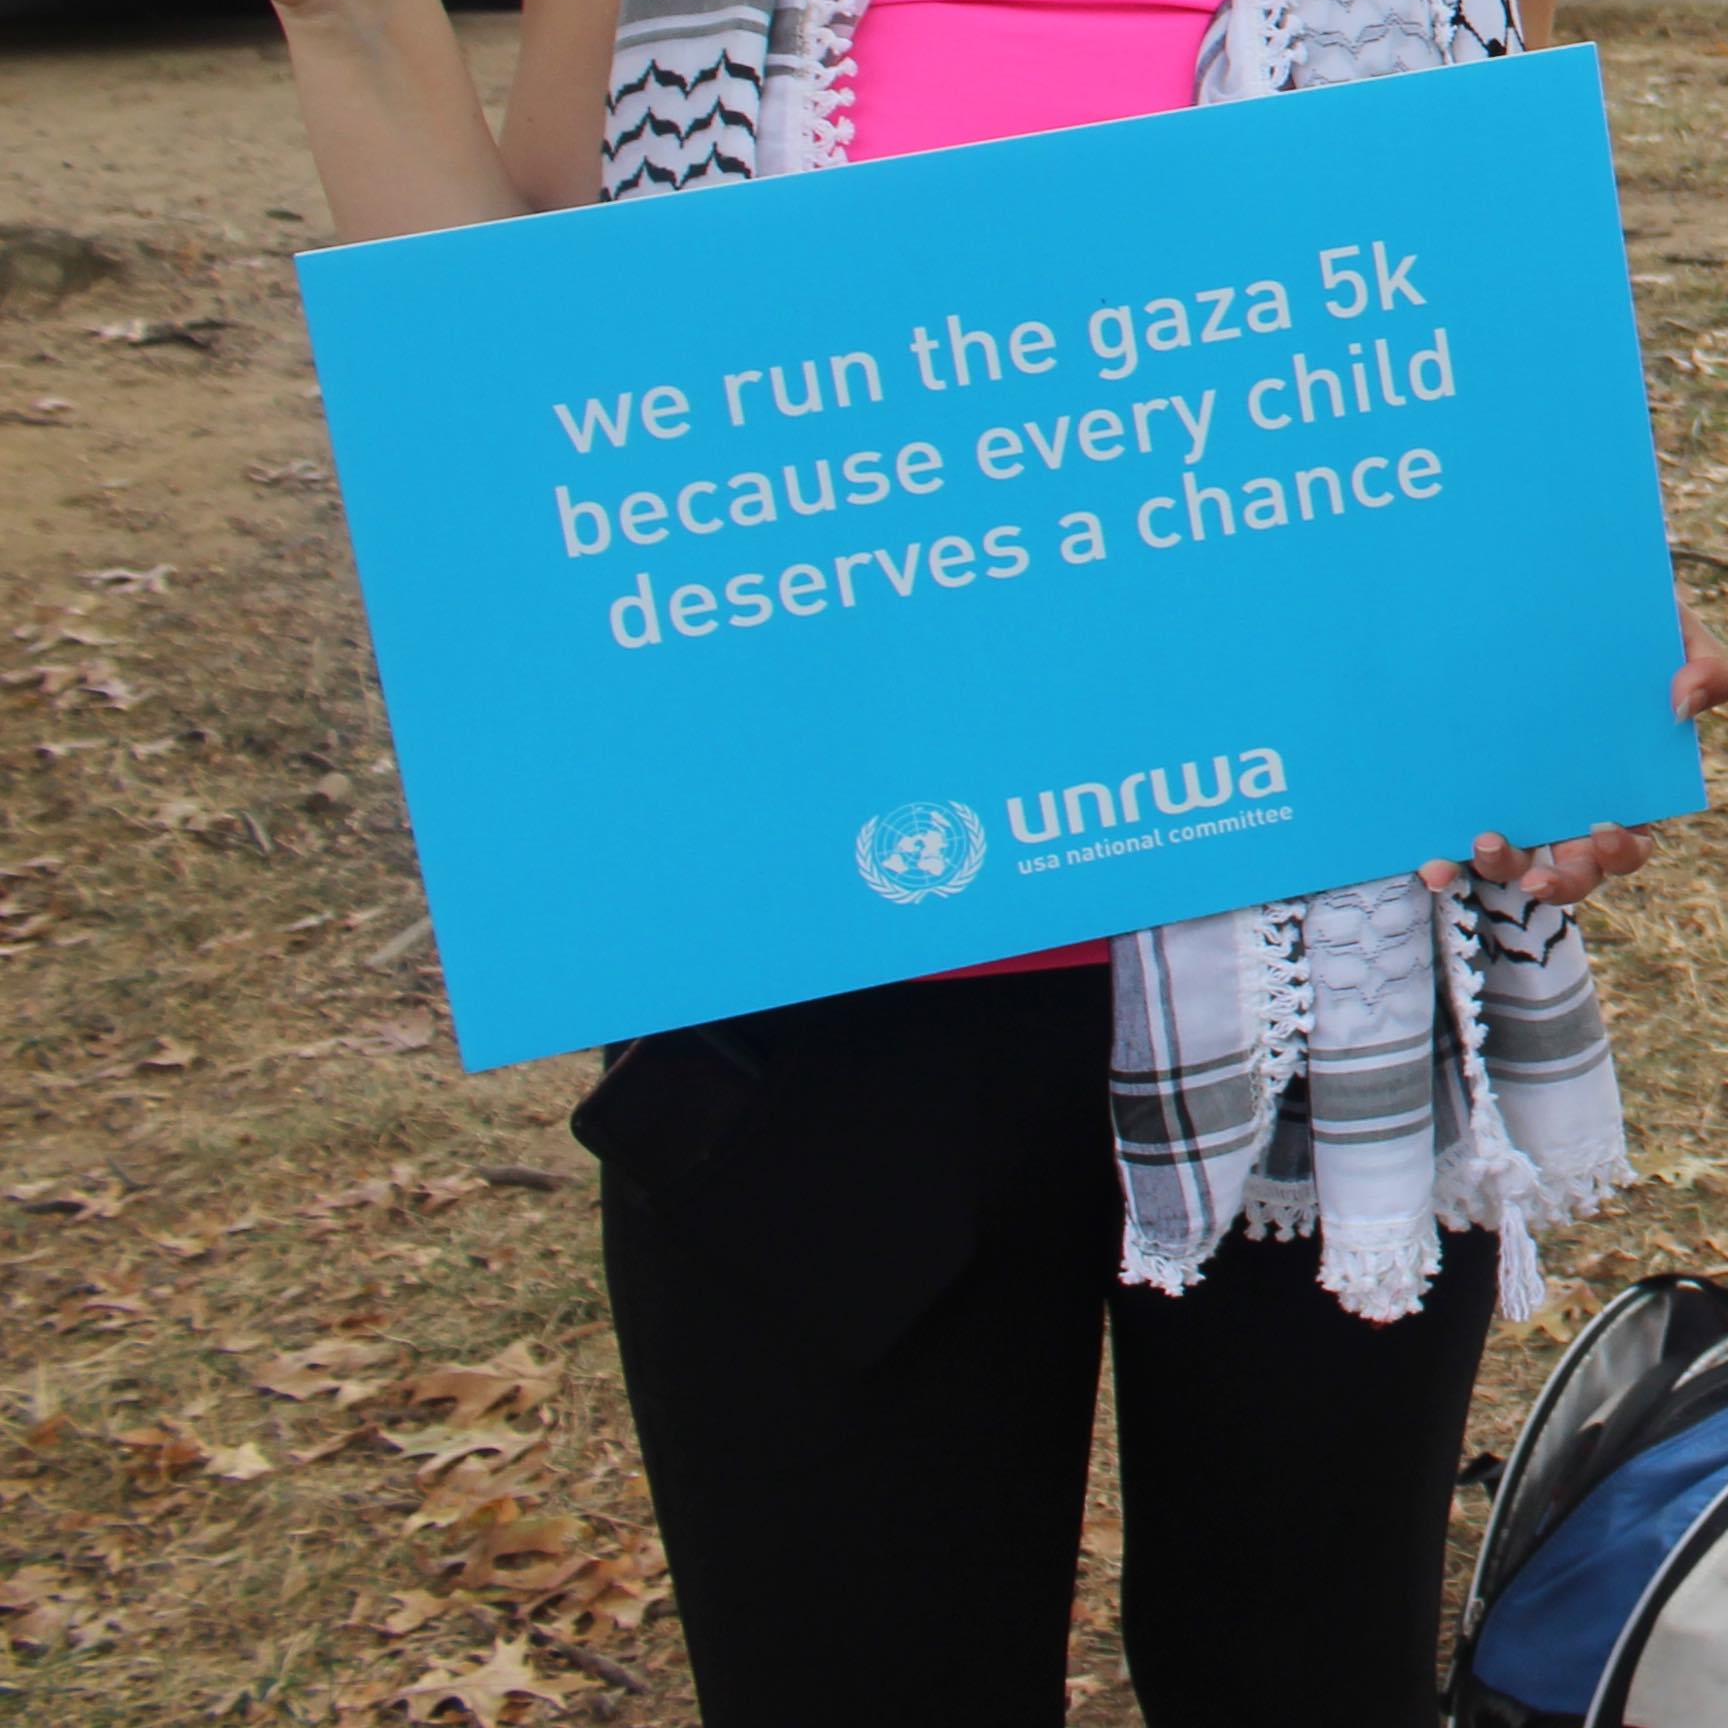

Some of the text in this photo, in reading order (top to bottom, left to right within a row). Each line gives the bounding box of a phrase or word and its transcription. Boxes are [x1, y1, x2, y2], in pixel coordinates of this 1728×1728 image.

[552, 239, 1428, 455] we run the gaza 5k
[553, 326, 1457, 559] because every child
[608, 447, 1443, 650] deserves a chance
[1005, 746, 1288, 845] unrwa
[1017, 805, 1293, 876] usa national committee
